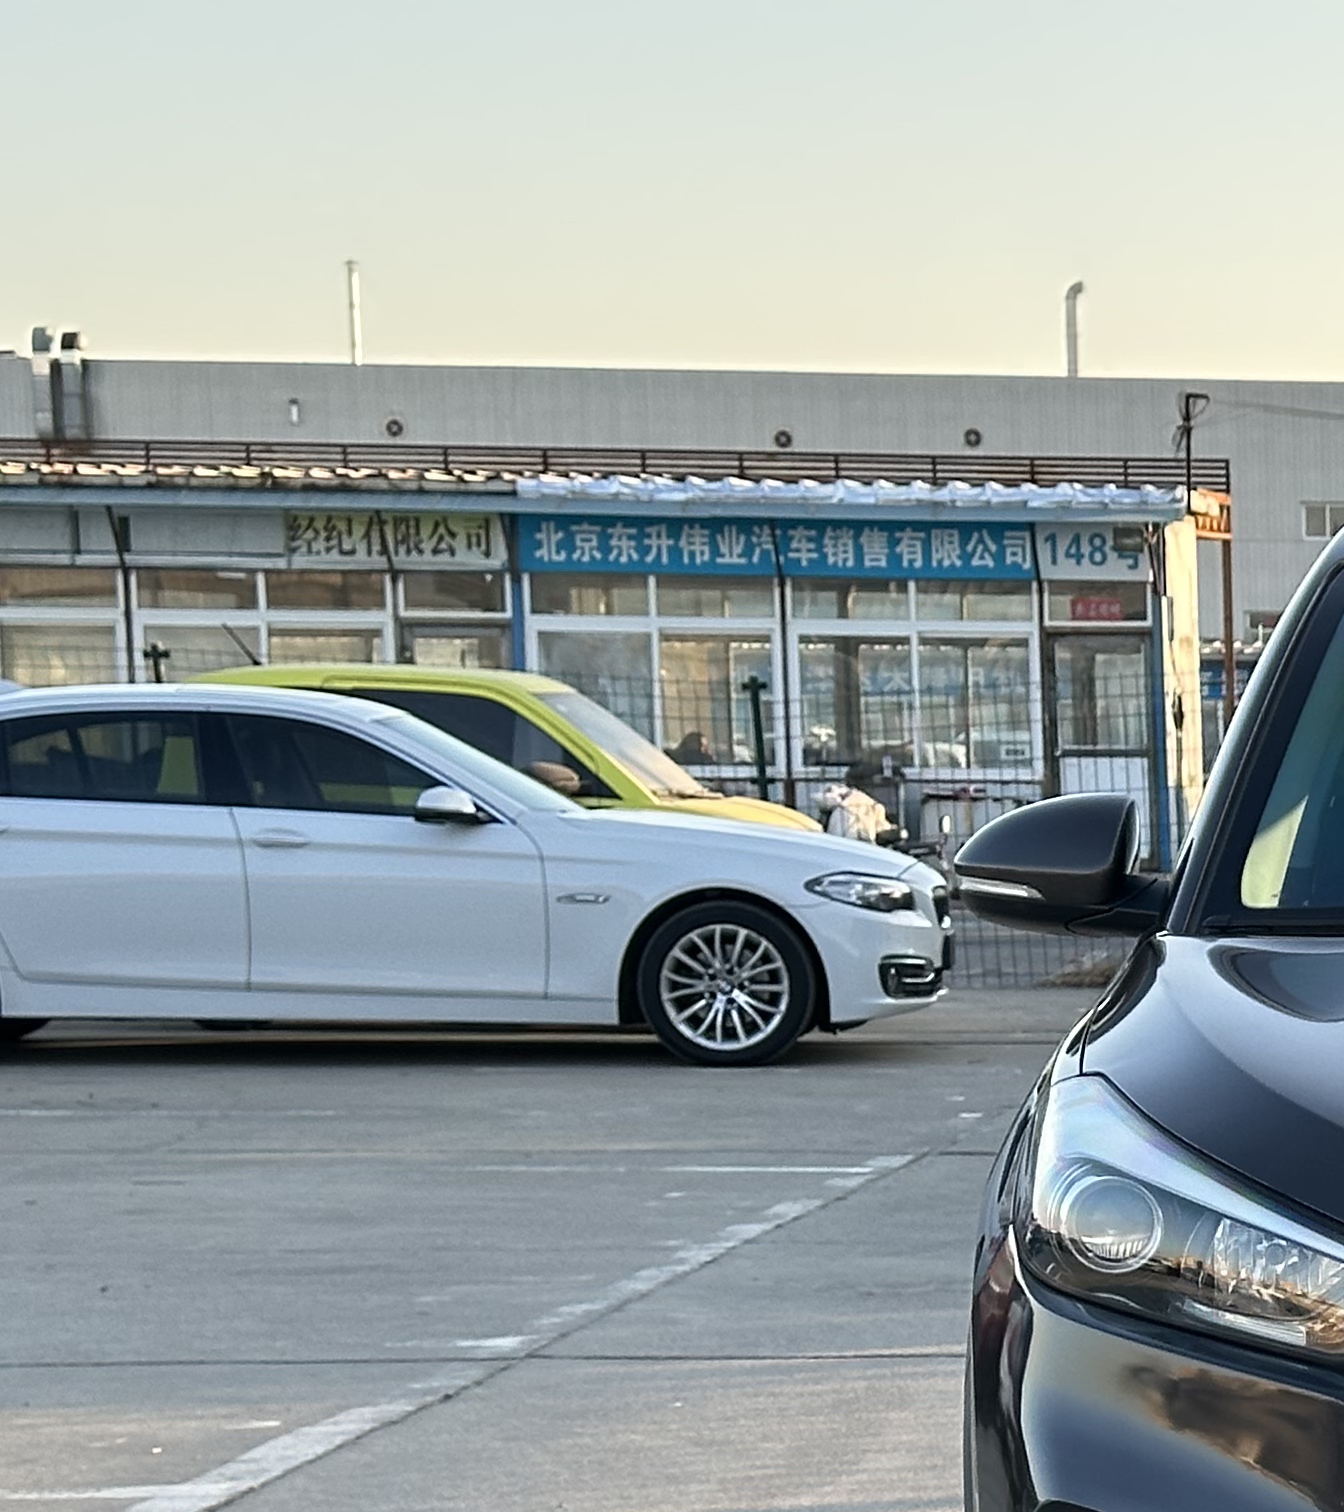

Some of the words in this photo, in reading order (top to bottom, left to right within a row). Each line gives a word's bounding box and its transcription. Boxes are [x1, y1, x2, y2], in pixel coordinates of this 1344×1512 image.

[534, 520, 1033, 571] 北京东升伟业汽车销售有限公司
